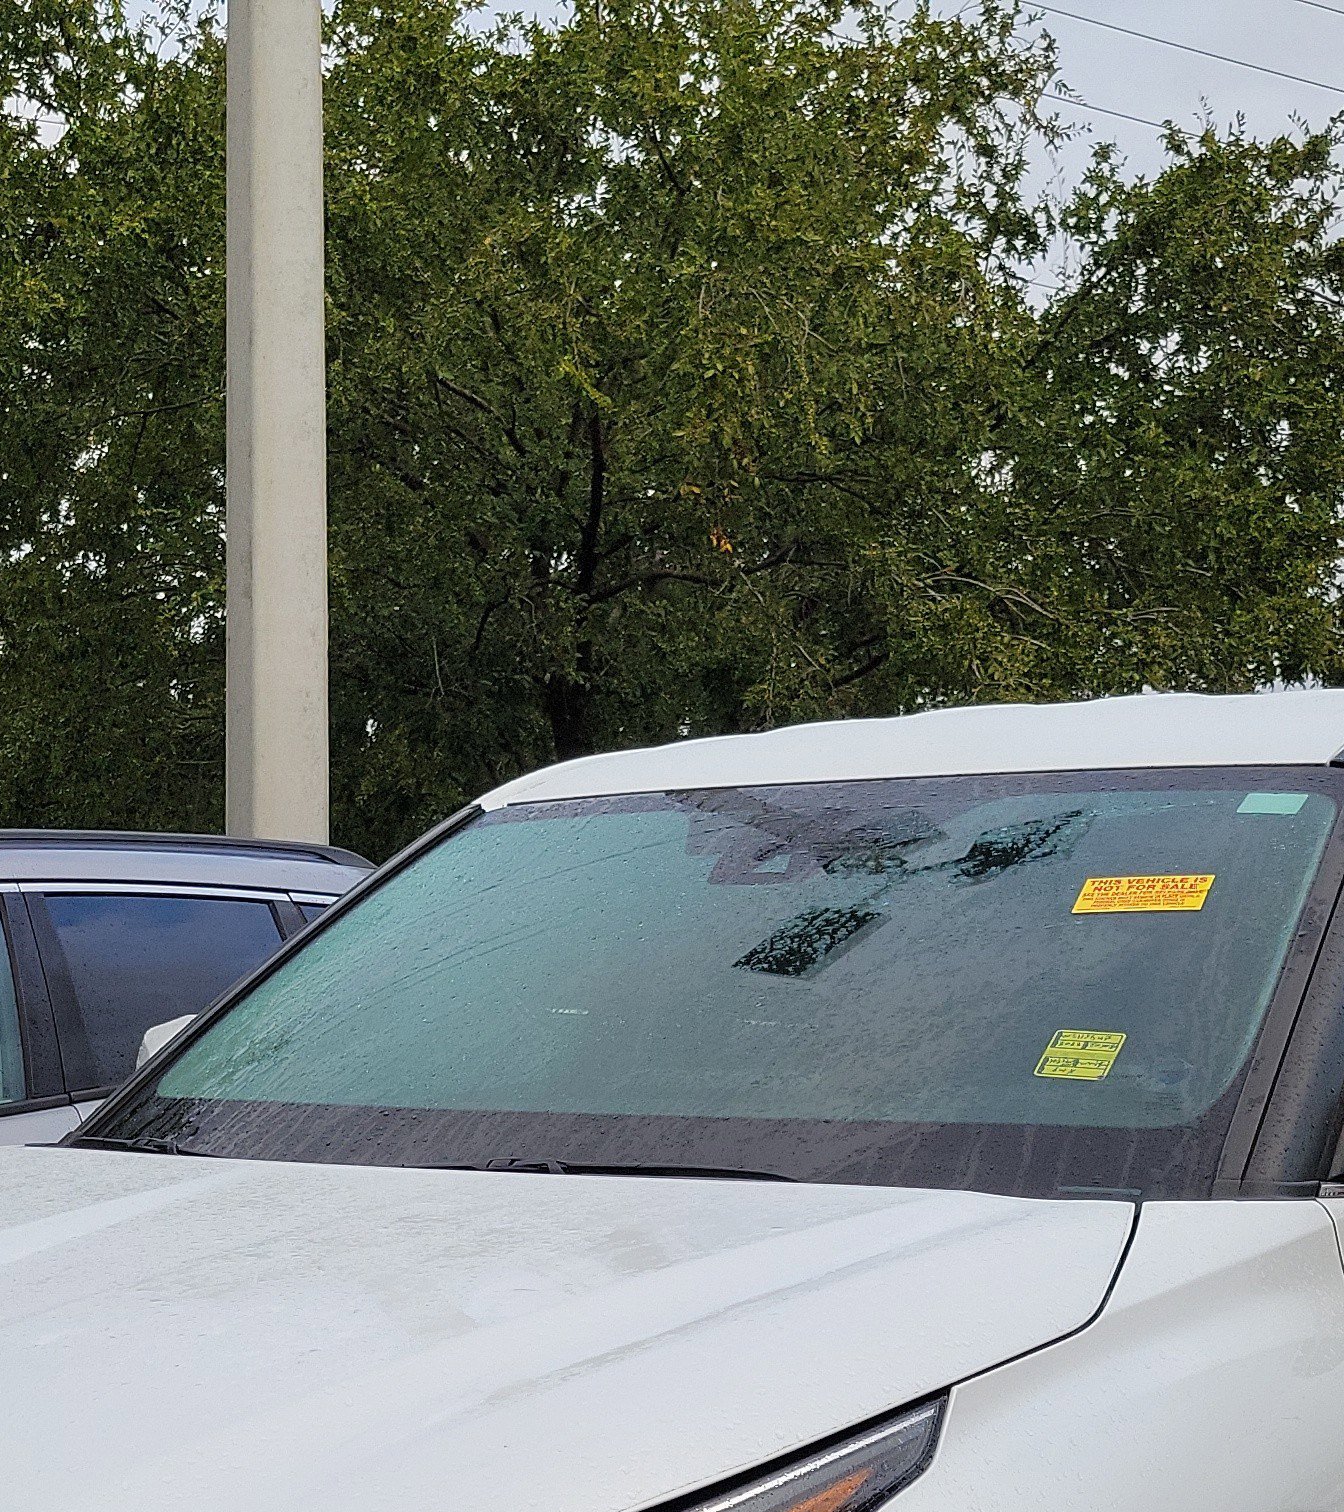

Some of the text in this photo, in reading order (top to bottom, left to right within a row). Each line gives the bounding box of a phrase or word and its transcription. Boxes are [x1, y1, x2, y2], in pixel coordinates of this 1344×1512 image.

[1090, 876, 1208, 887] THIS VEHICLE IS
[1092, 885, 1121, 893] NOT
